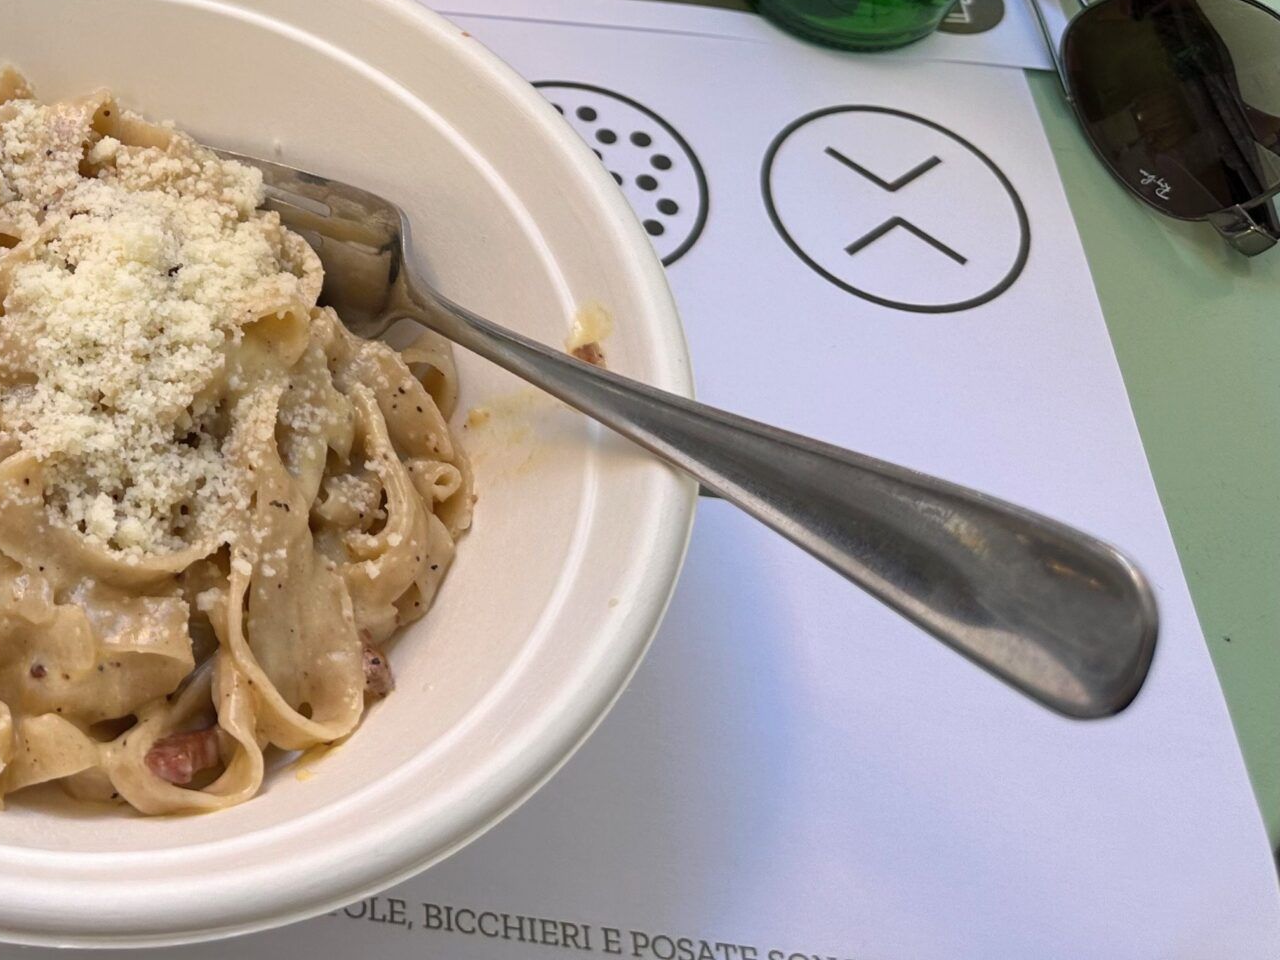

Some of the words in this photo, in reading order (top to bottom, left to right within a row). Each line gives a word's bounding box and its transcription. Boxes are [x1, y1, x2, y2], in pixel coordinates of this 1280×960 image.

[422, 902, 594, 951] BICCHIERI
[601, 927, 622, 955] E
[629, 930, 758, 960] POSATE
